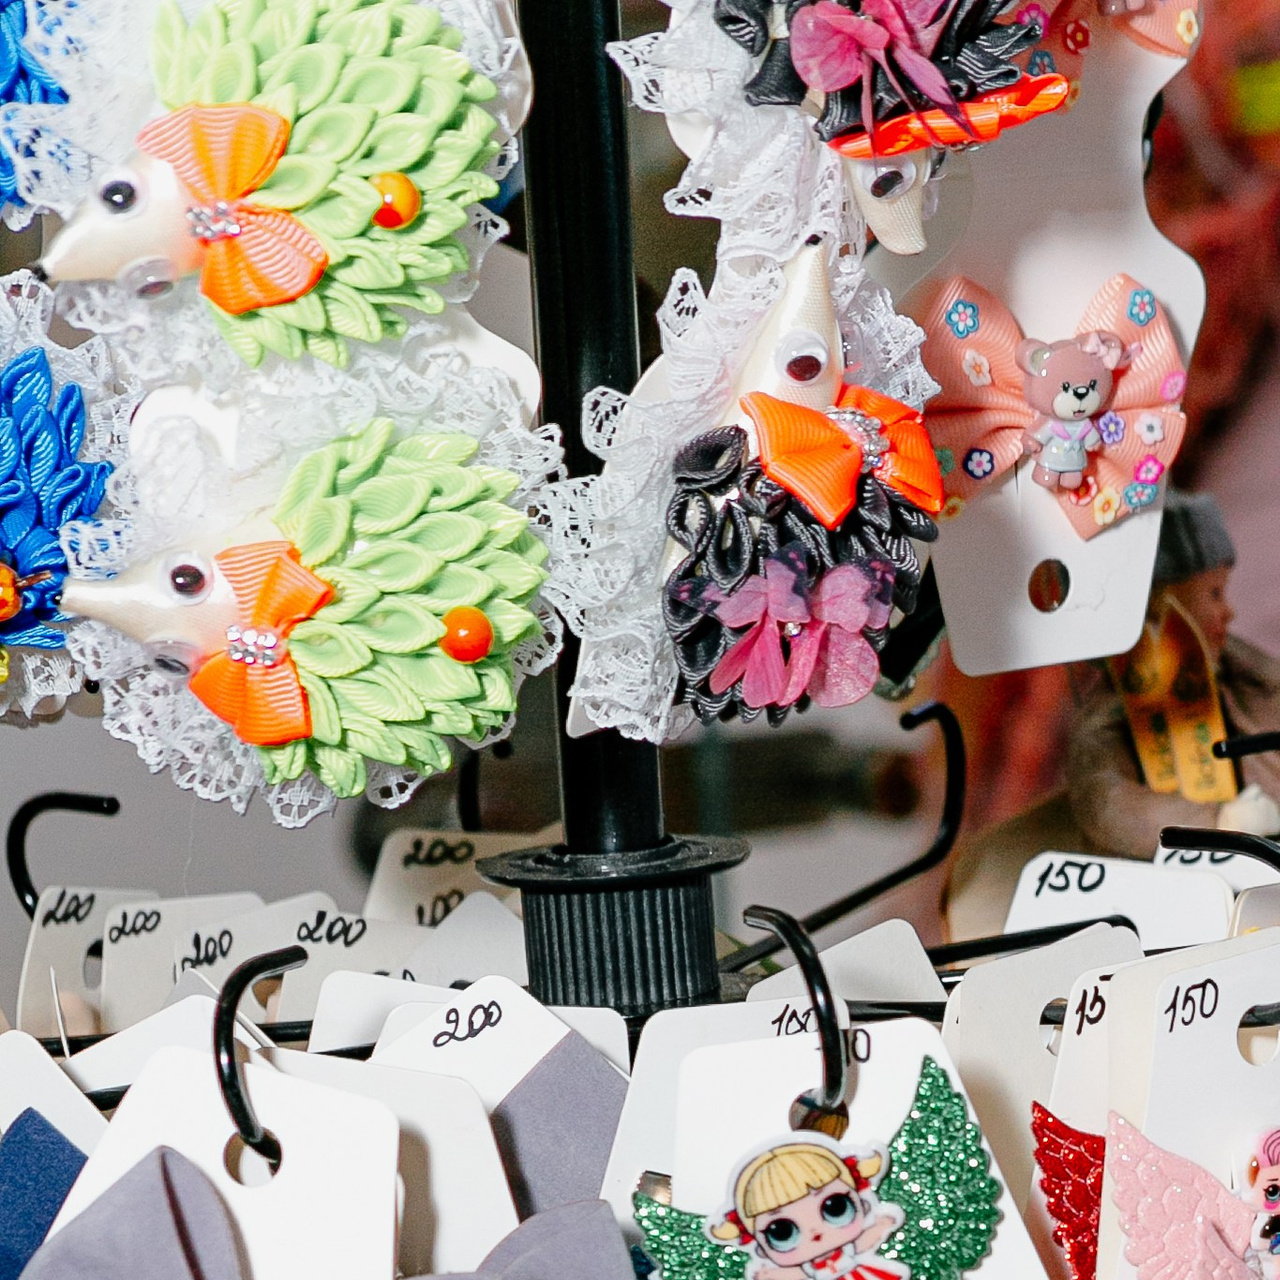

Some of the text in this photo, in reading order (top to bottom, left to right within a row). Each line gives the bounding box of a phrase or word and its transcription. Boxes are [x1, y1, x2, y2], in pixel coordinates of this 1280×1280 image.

[403, 838, 474, 868] 200
[1035, 861, 1105, 896] 150
[42, 889, 95, 928] 200
[109, 909, 161, 944] 200
[298, 910, 367, 947] 200
[181, 930, 233, 971] 200
[433, 1000, 502, 1047] 200
[1075, 973, 1115, 1036] 15
[1165, 978, 1219, 1033] 150
